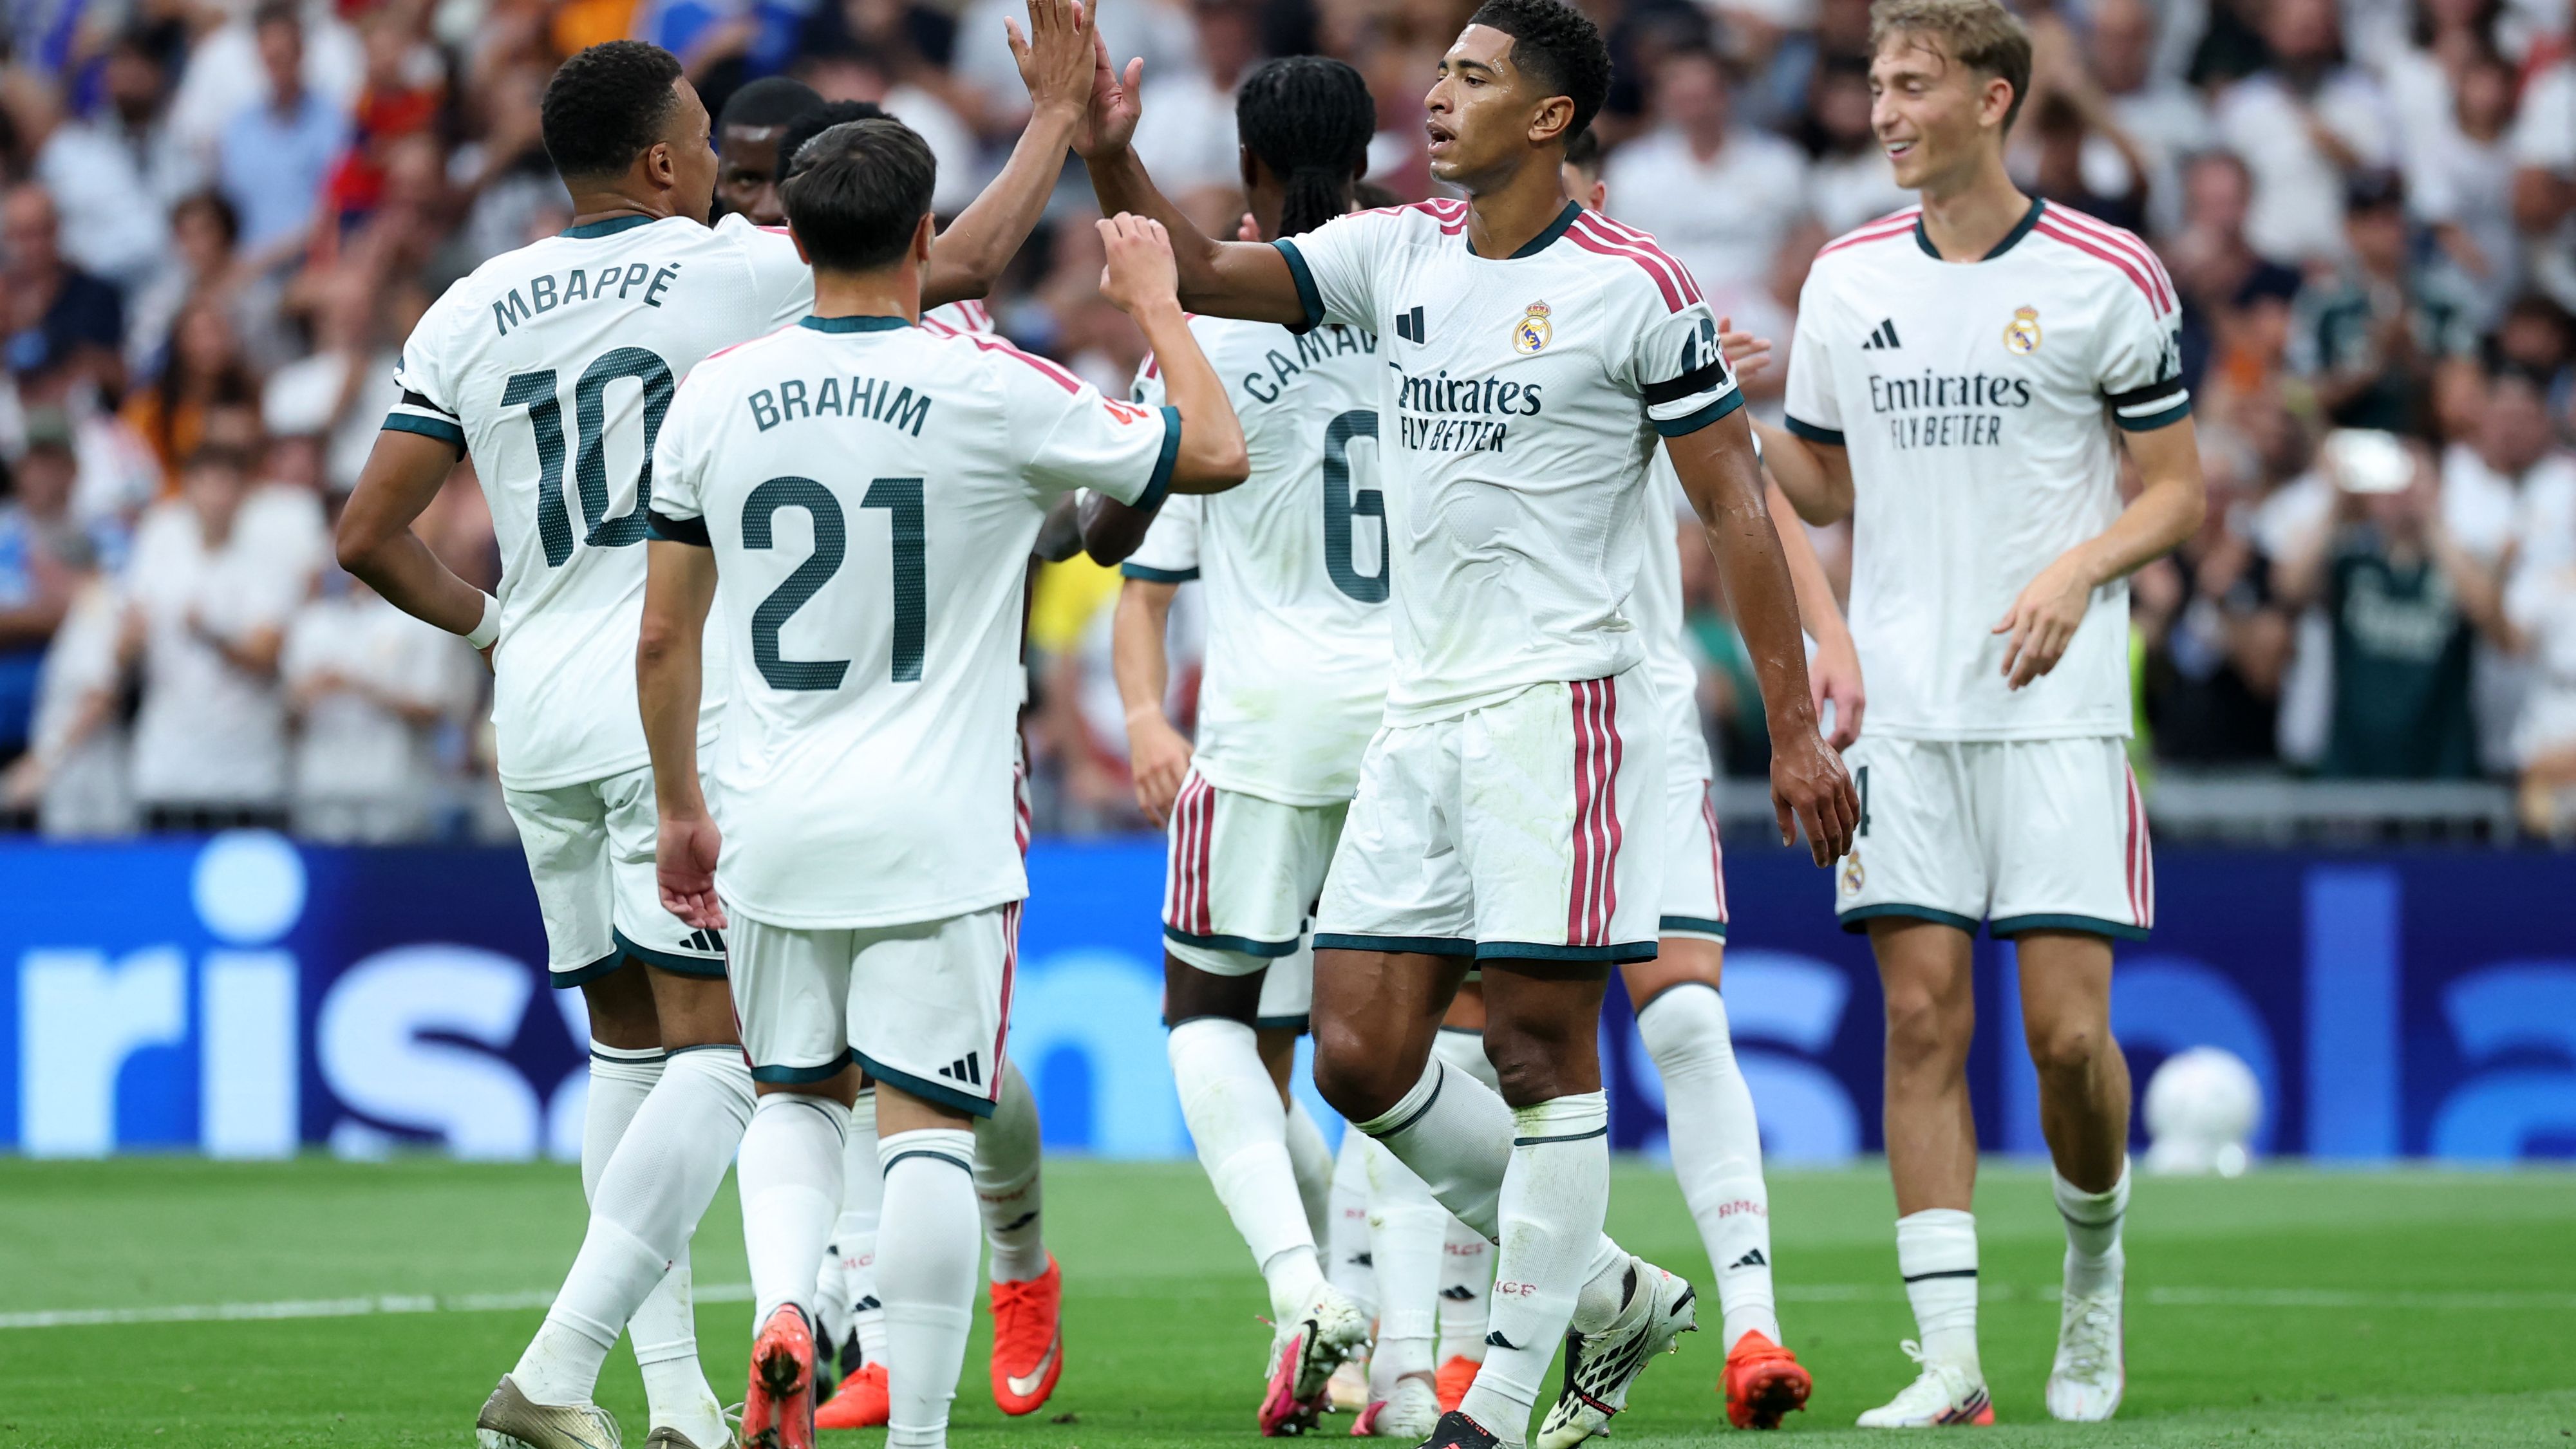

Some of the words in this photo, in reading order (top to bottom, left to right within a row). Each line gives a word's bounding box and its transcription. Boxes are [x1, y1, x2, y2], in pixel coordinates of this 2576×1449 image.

[492, 262, 681, 337] MBAPPÉ
[748, 376, 932, 438] BRAHIM
[1869, 368, 2030, 413] Emirates
[500, 346, 675, 568] 10
[1401, 415, 1429, 451] FLY
[1429, 418, 1507, 453] BETTER
[1891, 418, 1917, 449] FLY
[1923, 414, 2000, 447] BETTER
[741, 476, 926, 691] 21
